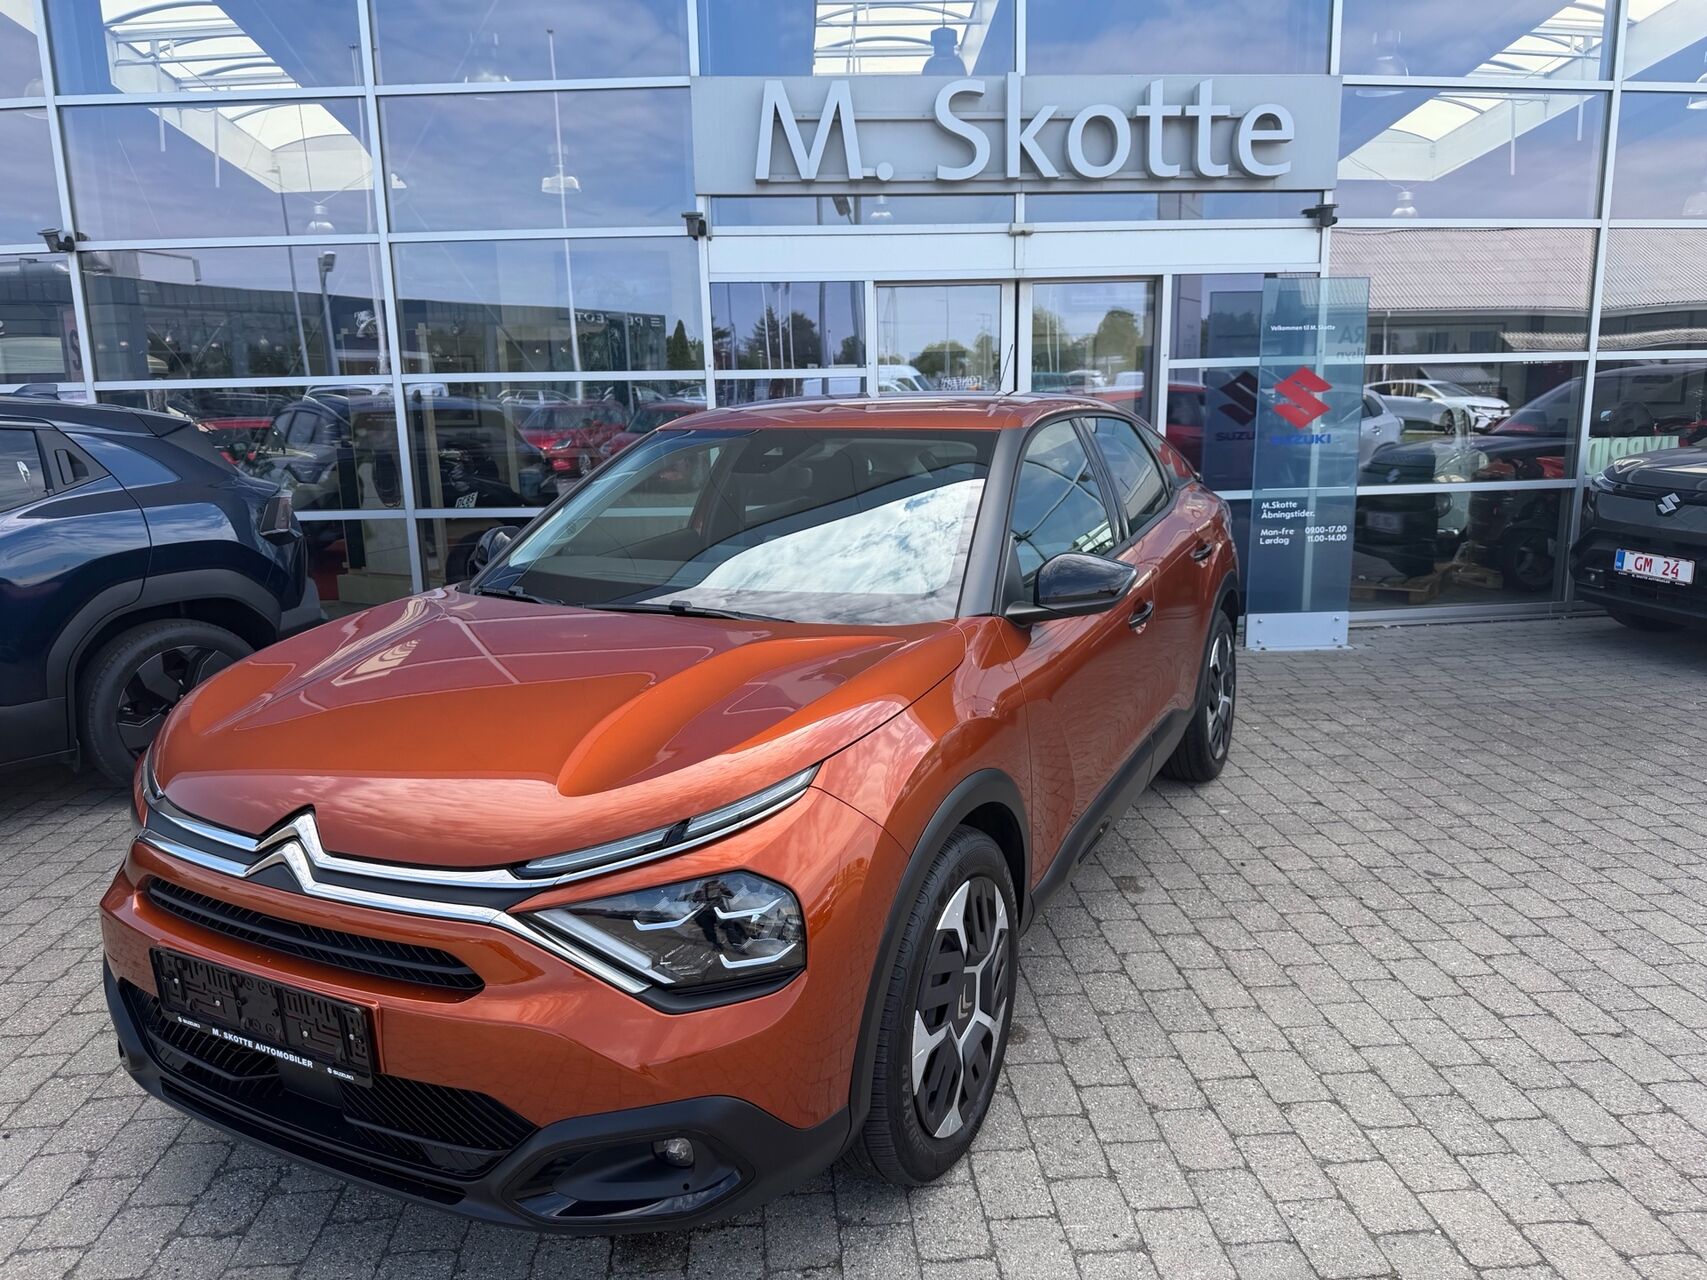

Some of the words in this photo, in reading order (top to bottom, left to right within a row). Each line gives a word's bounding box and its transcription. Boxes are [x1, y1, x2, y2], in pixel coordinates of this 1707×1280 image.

[754, 79, 895, 183] M.
[933, 71, 1296, 183] Skotte
[1270, 324, 1303, 332] Velkommen
[1270, 433, 1332, 445] SUZUKI
[1261, 501, 1298, 510] M.Skotte
[1260, 527, 1295, 536] Man-fre
[1259, 537, 1290, 546] Lørdag
[1307, 534, 1347, 543] 11.00-14.00
[1634, 556, 1653, 573] GM
[1662, 561, 1680, 577] 24
[212, 1027, 222, 1037] M.
[223, 1031, 253, 1048] SKOTTE
[255, 1042, 314, 1069] AUTOMOBILER
